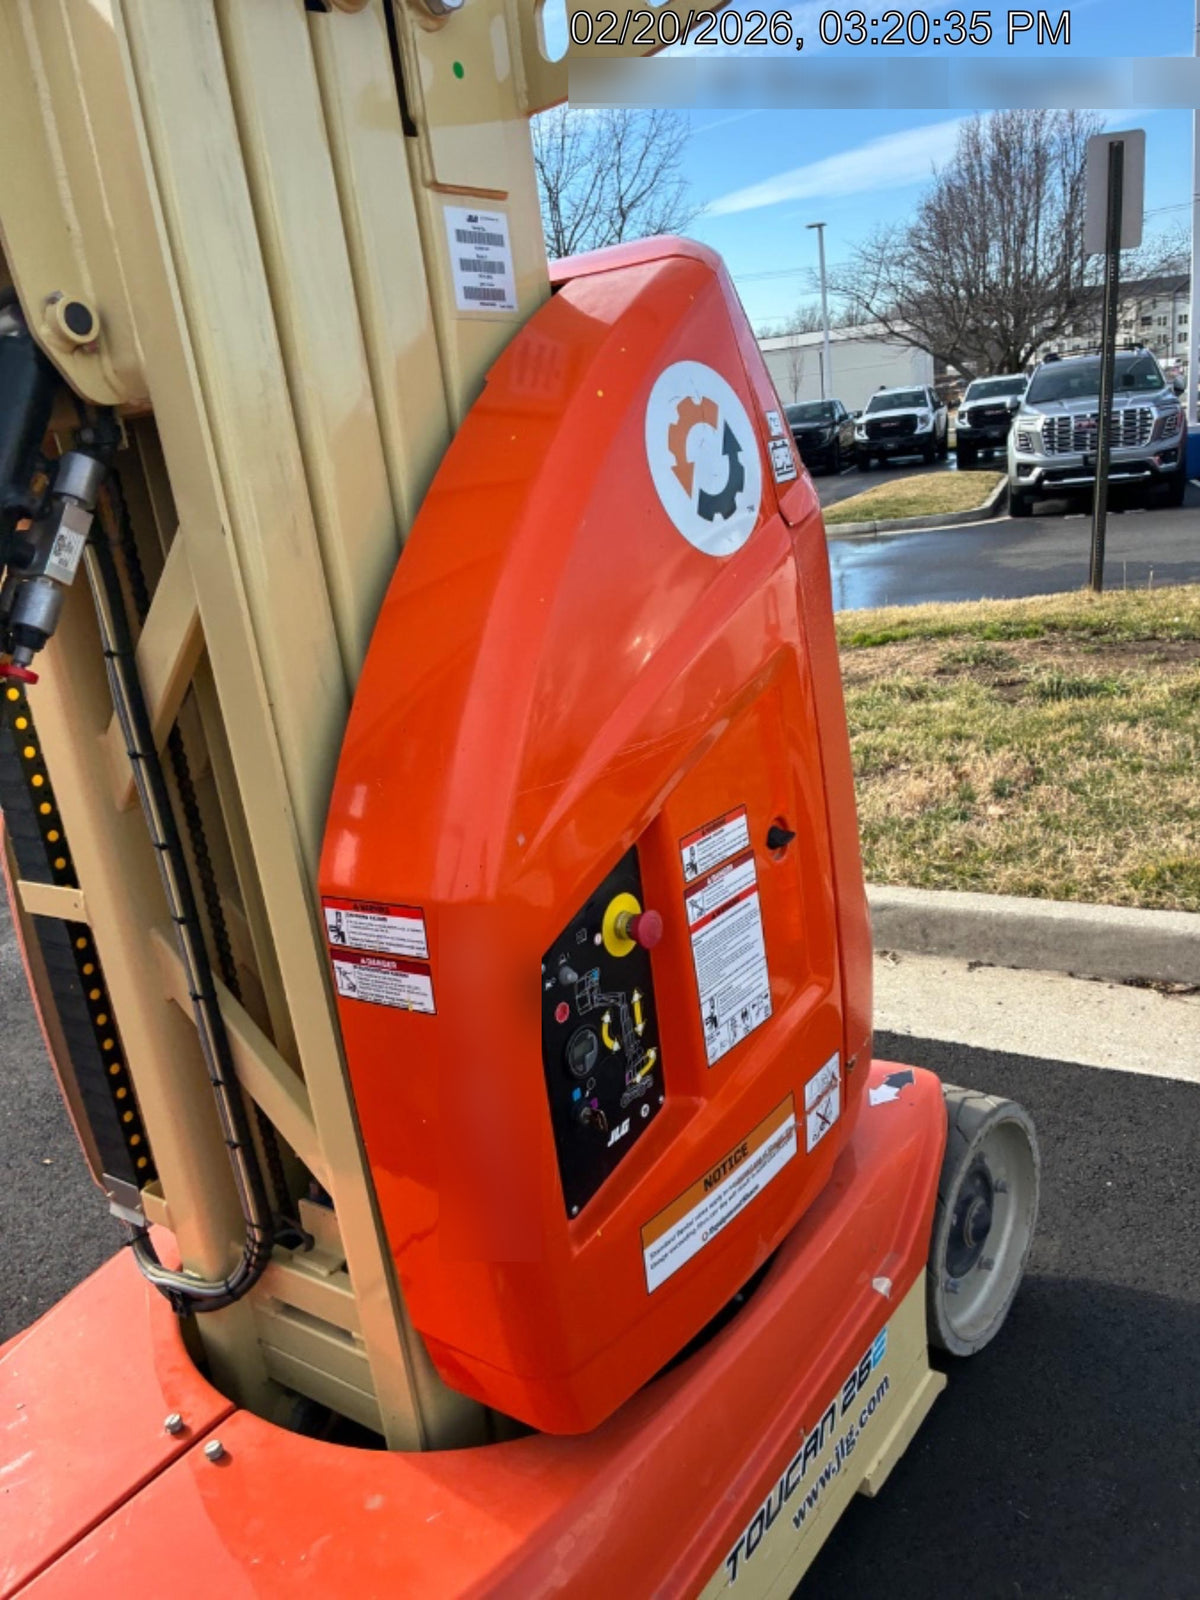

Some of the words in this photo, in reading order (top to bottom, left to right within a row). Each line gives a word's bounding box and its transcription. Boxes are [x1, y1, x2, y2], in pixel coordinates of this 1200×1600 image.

[607, 1117, 630, 1147] JLG
[703, 1142, 749, 1191] NOTICE
[725, 1401, 836, 1585] TOUCAN
[841, 1326, 888, 1418] 26E
[792, 1375, 890, 1531] www.jlg.com
